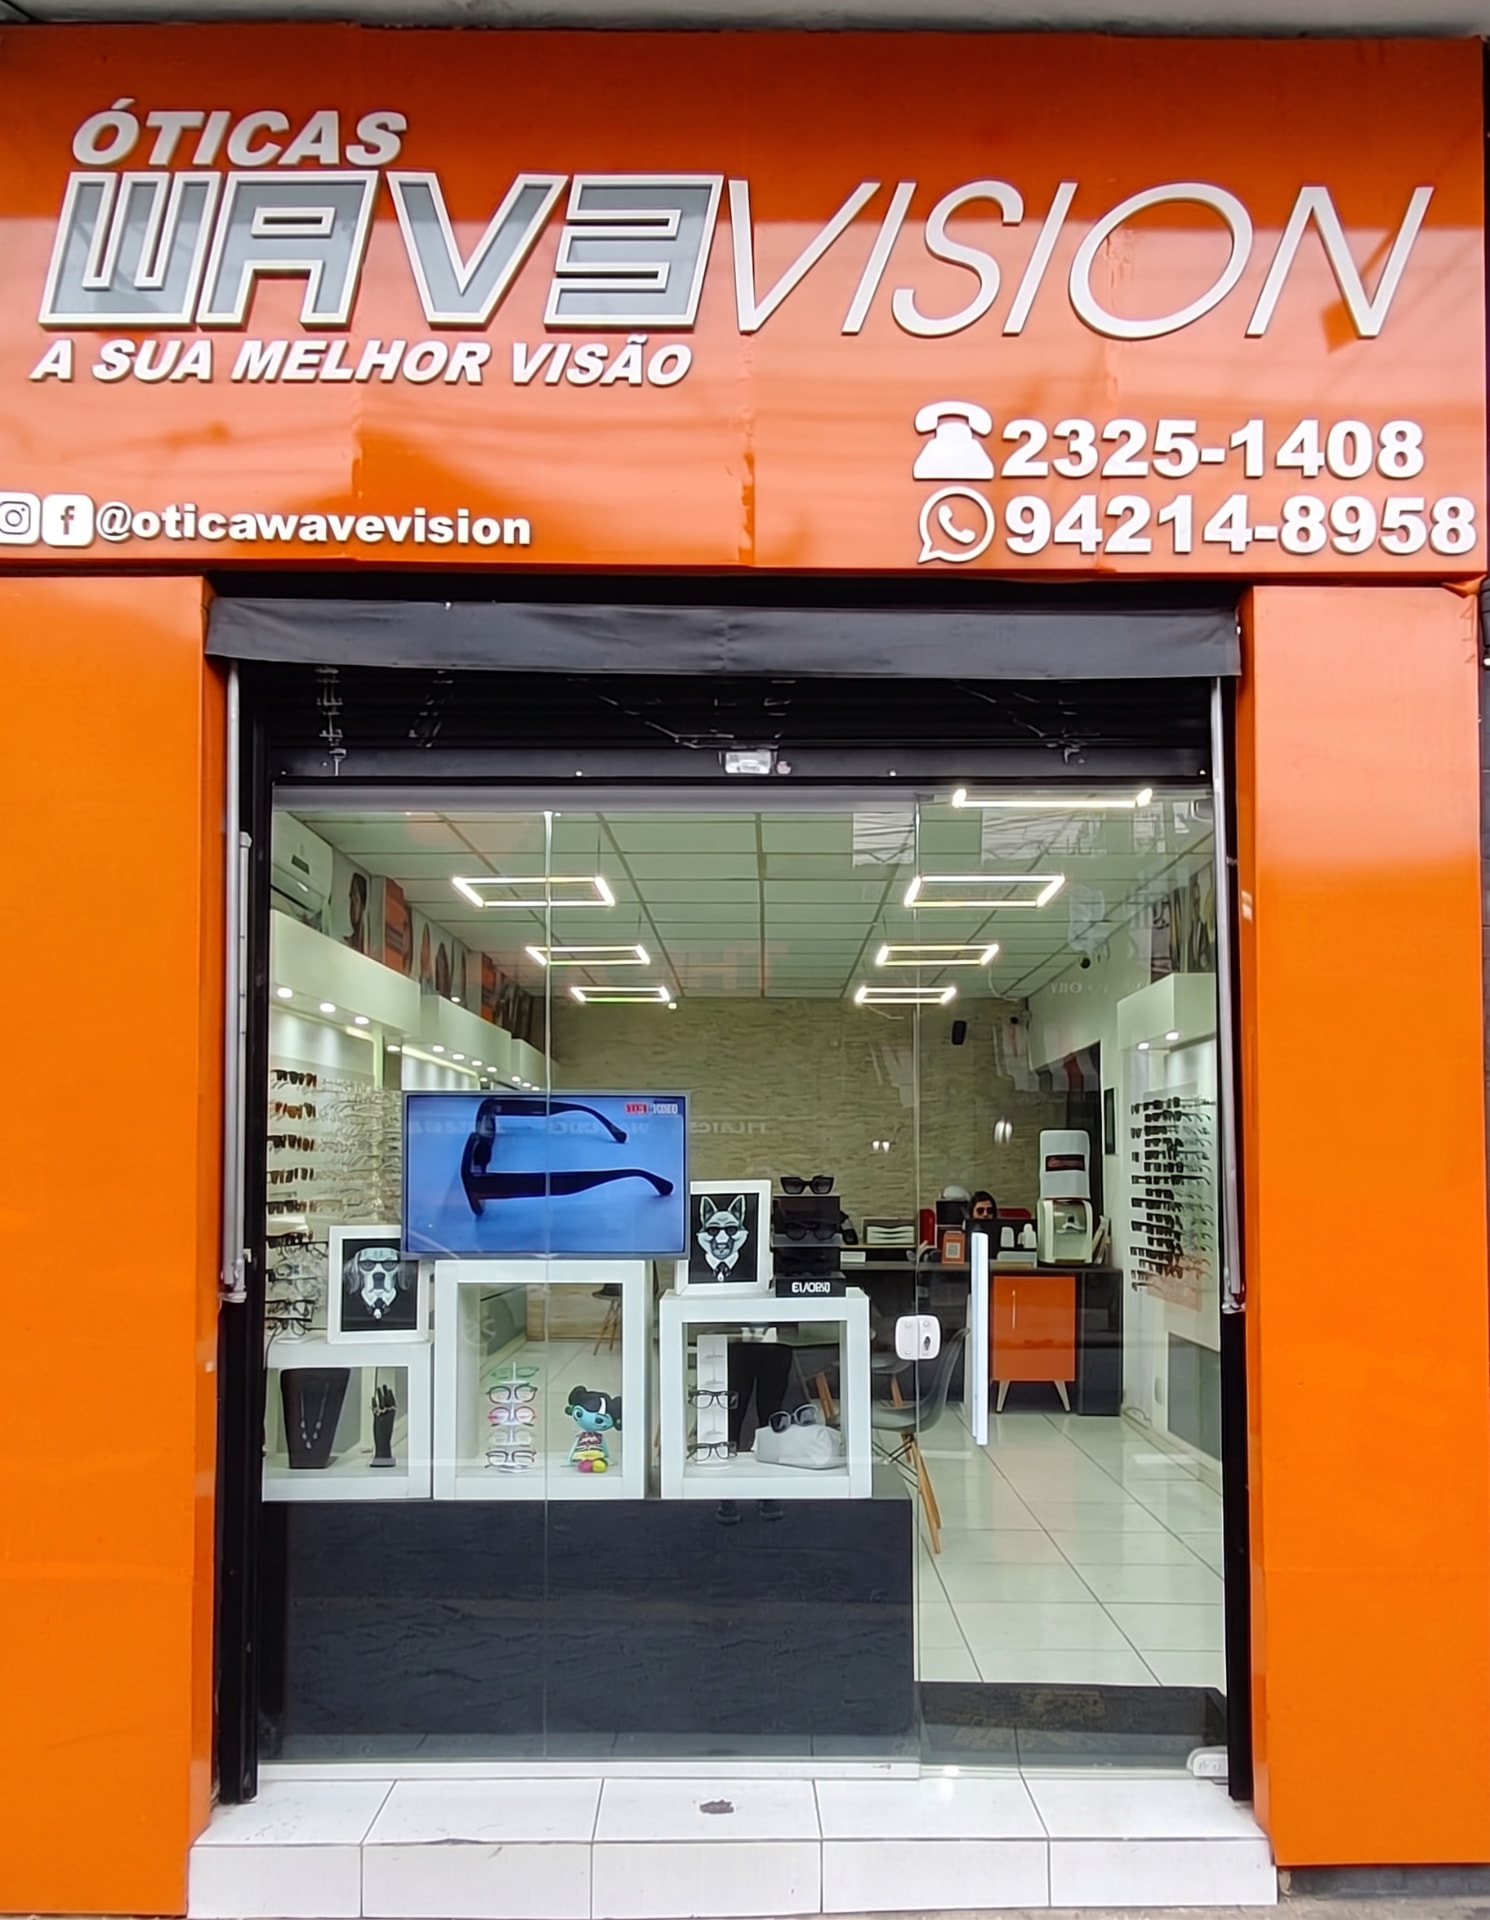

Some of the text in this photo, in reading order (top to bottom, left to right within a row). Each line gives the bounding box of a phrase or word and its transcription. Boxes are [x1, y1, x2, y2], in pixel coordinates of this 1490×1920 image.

[72, 98, 408, 168] ÓTICAS
[727, 178, 1434, 340] VISION
[30, 333, 694, 387] A SUA MELHOR VISÃO
[1001, 418, 1426, 479] 2325-1408
[97, 501, 532, 545] @oticawavevision
[1004, 493, 1478, 557] 94214-8958
